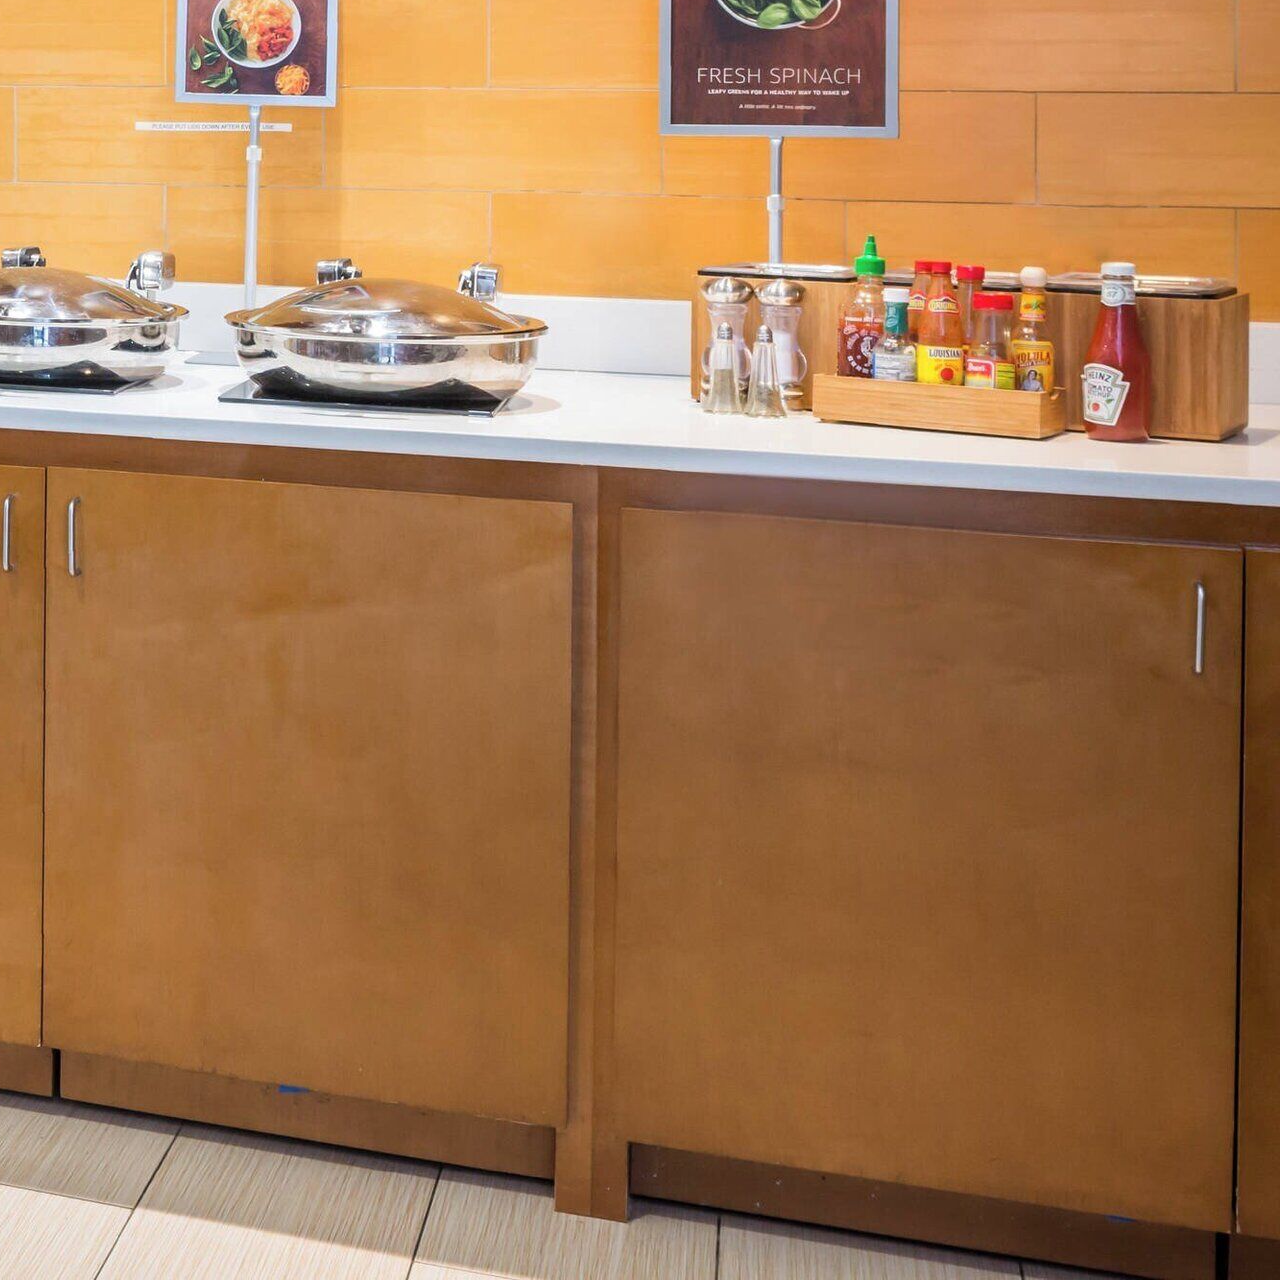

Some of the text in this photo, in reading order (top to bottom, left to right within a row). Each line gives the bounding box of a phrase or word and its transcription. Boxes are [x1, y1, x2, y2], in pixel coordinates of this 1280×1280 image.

[697, 67, 861, 84] FRESH SPINACH
[929, 348, 961, 358] LOUISIAN
